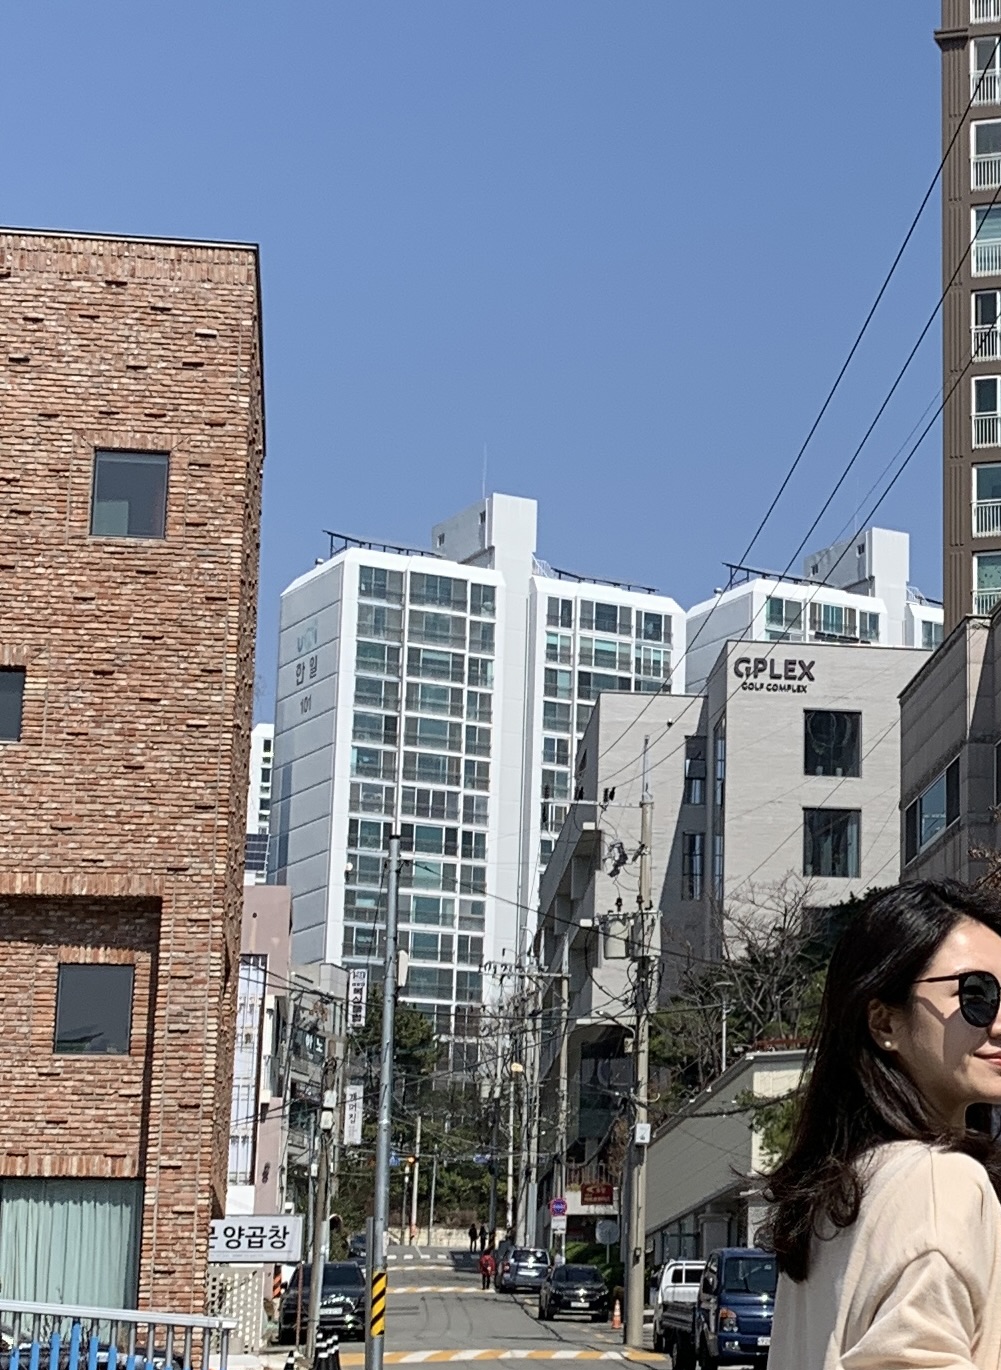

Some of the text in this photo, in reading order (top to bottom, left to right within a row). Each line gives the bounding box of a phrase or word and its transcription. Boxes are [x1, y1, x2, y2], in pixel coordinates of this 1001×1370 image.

[733, 656, 816, 682] GPLEX
[740, 681, 808, 694] GOLF COMPLEX
